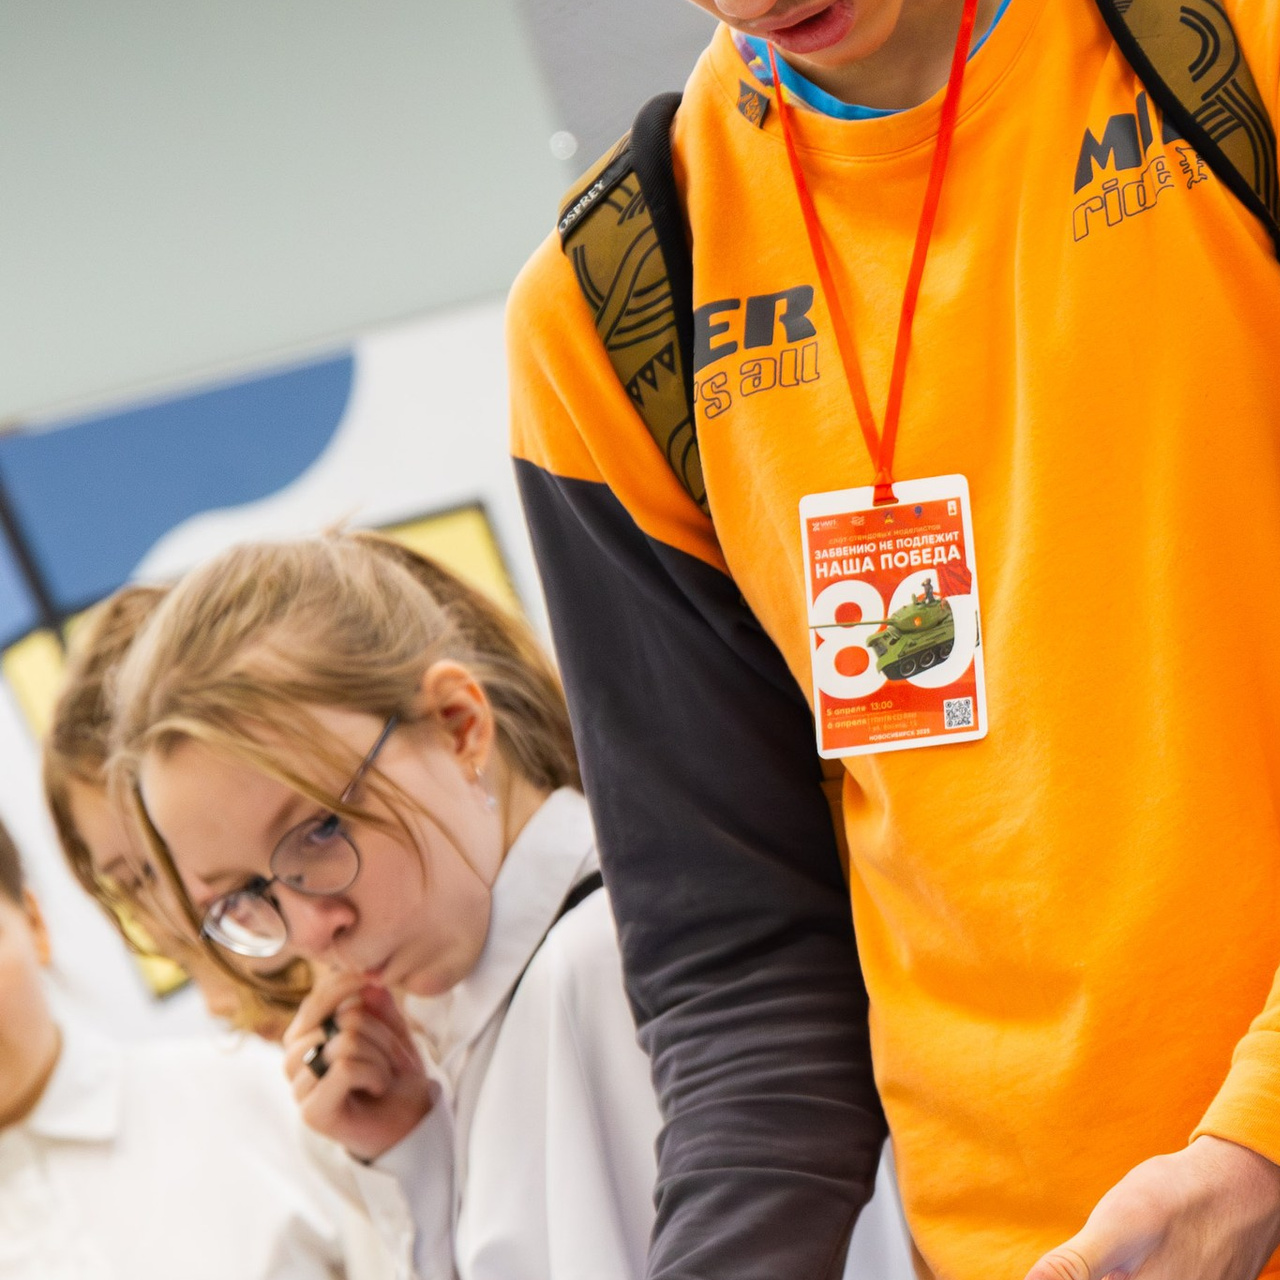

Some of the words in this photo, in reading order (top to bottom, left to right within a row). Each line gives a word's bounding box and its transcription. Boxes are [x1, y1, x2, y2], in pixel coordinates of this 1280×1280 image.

[559, 179, 605, 233] OSPREY
[693, 285, 817, 374] ER
[814, 542, 877, 560] ЗАБВЕНИЮ
[879, 539, 894, 551] НЕ
[896, 531, 960, 549] ПОДЛЕЖИТ
[815, 557, 875, 579] НАША
[880, 544, 962, 570] ПОБЕДА
[870, 700, 893, 711] 13:00
[868, 729, 915, 741] НОВОСИБИРСК
